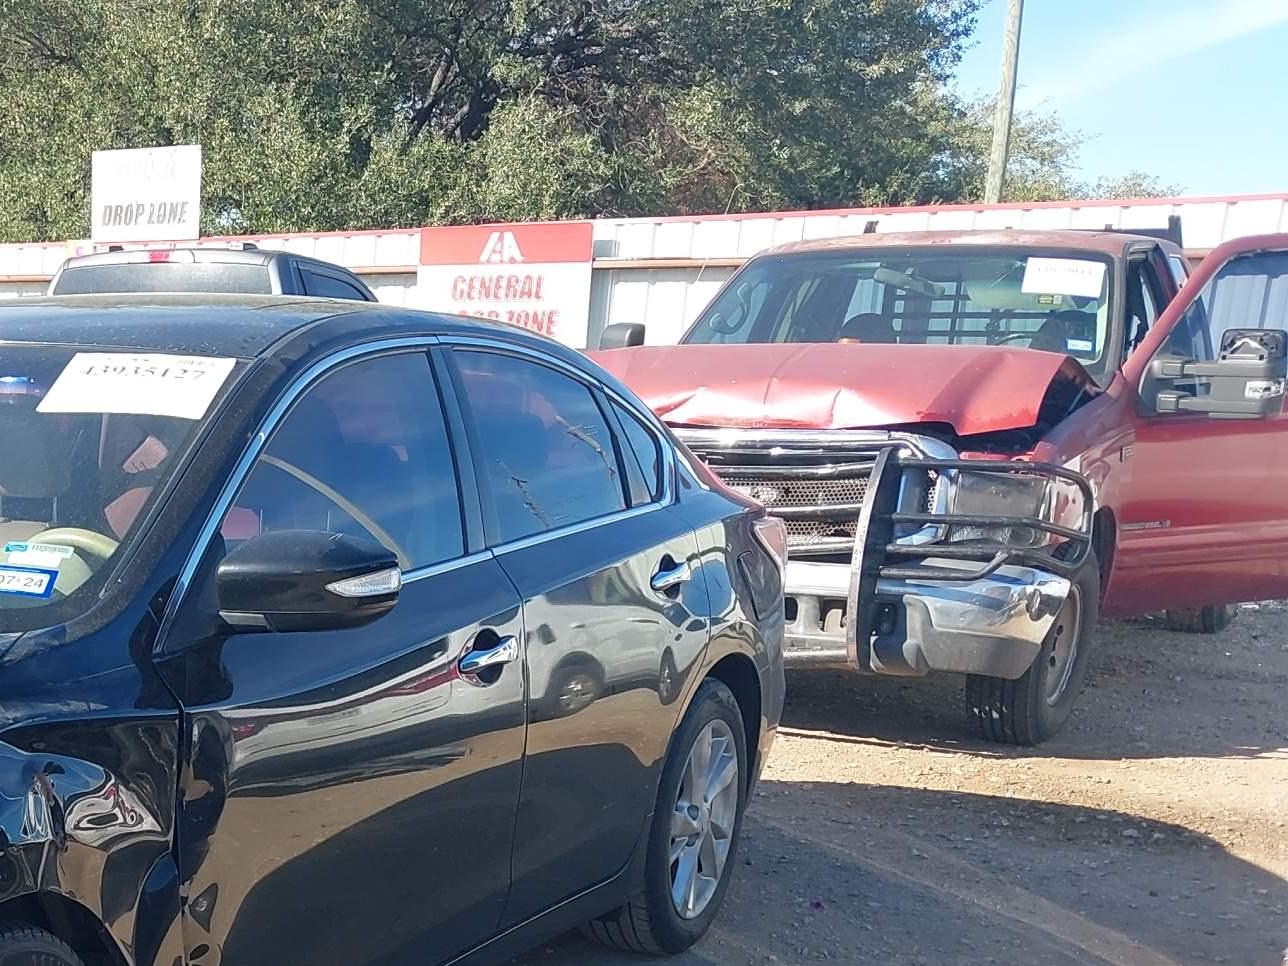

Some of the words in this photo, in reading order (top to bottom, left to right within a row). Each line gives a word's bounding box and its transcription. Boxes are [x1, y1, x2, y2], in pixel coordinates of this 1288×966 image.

[102, 203, 145, 226] DROP
[147, 201, 189, 225] ZONE
[452, 273, 544, 302] GENERAL
[23, 577, 44, 588] 24
